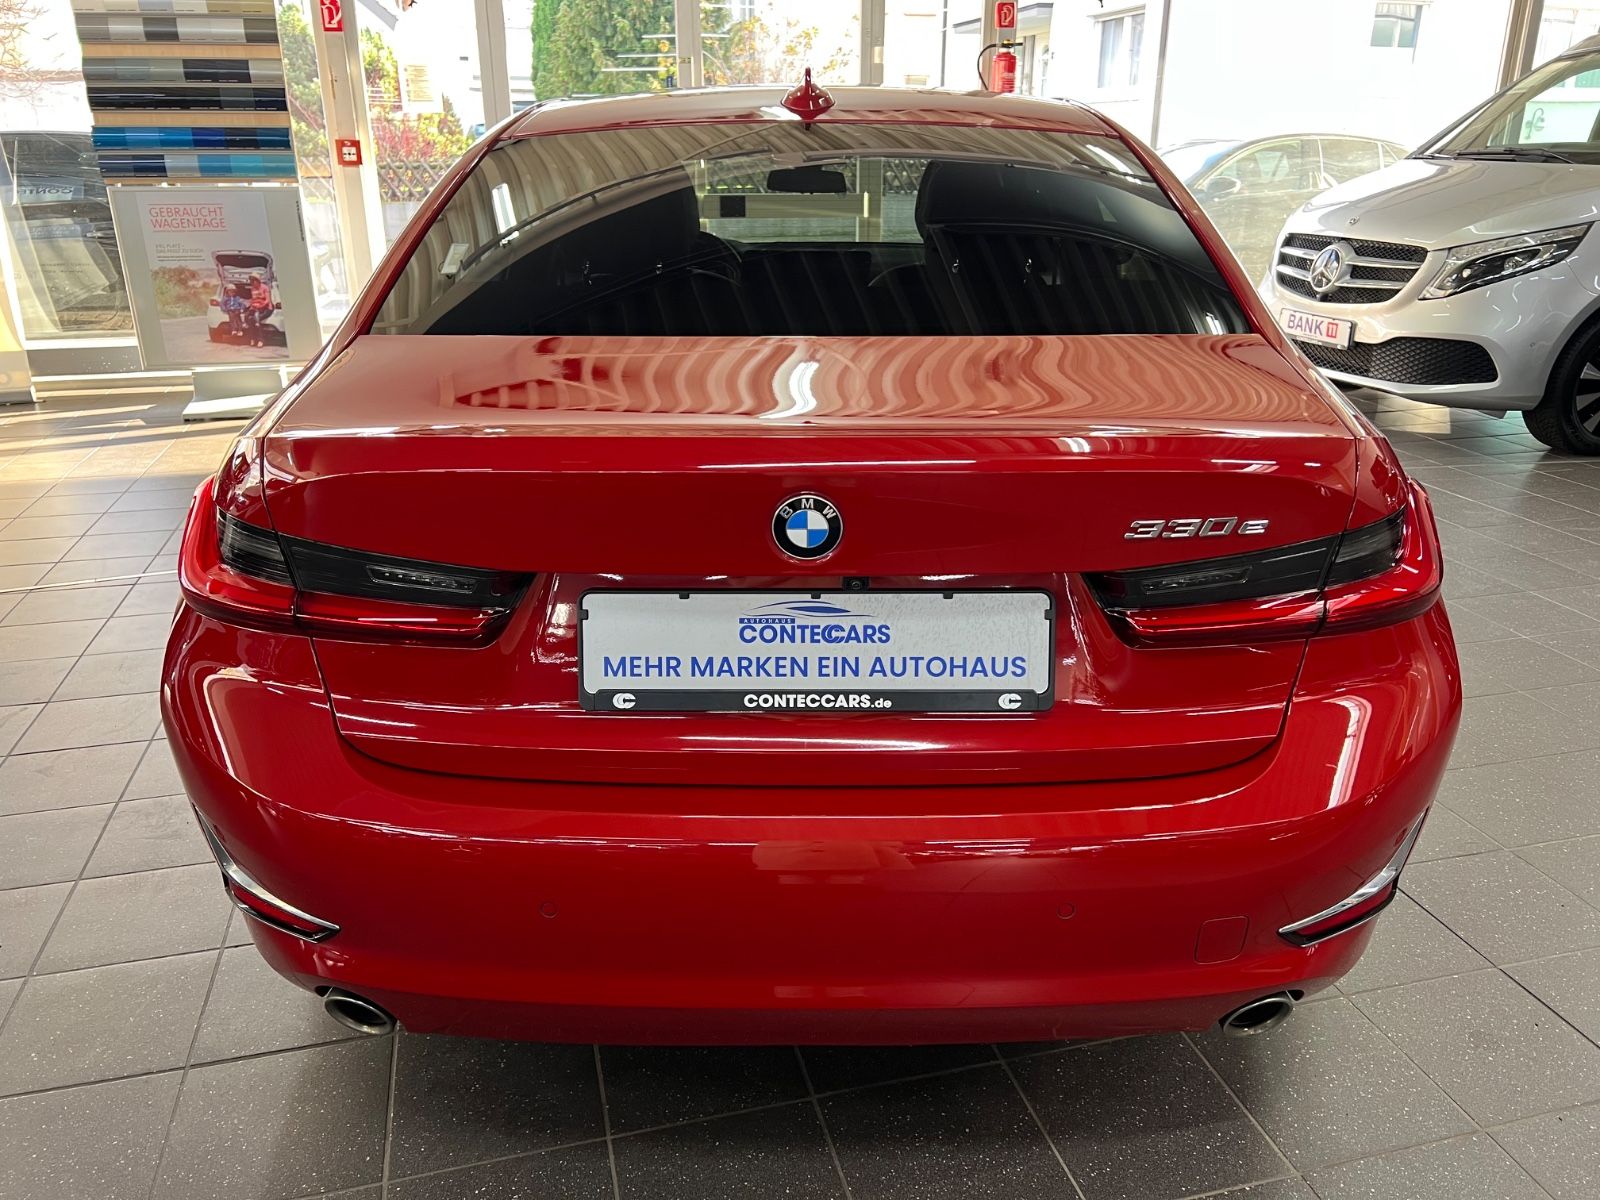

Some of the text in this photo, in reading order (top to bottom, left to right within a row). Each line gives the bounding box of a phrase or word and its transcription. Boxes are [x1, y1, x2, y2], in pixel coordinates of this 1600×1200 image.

[149, 206, 225, 218] GEBRAUCHT
[150, 218, 227, 229] WAGENTAGE
[1287, 313, 1324, 336] BANK
[779, 498, 837, 519] BMW
[603, 656, 1027, 678] MEHR MARKEN EIN AUTOHAUS
[743, 693, 893, 709] CONTECCARS.de
